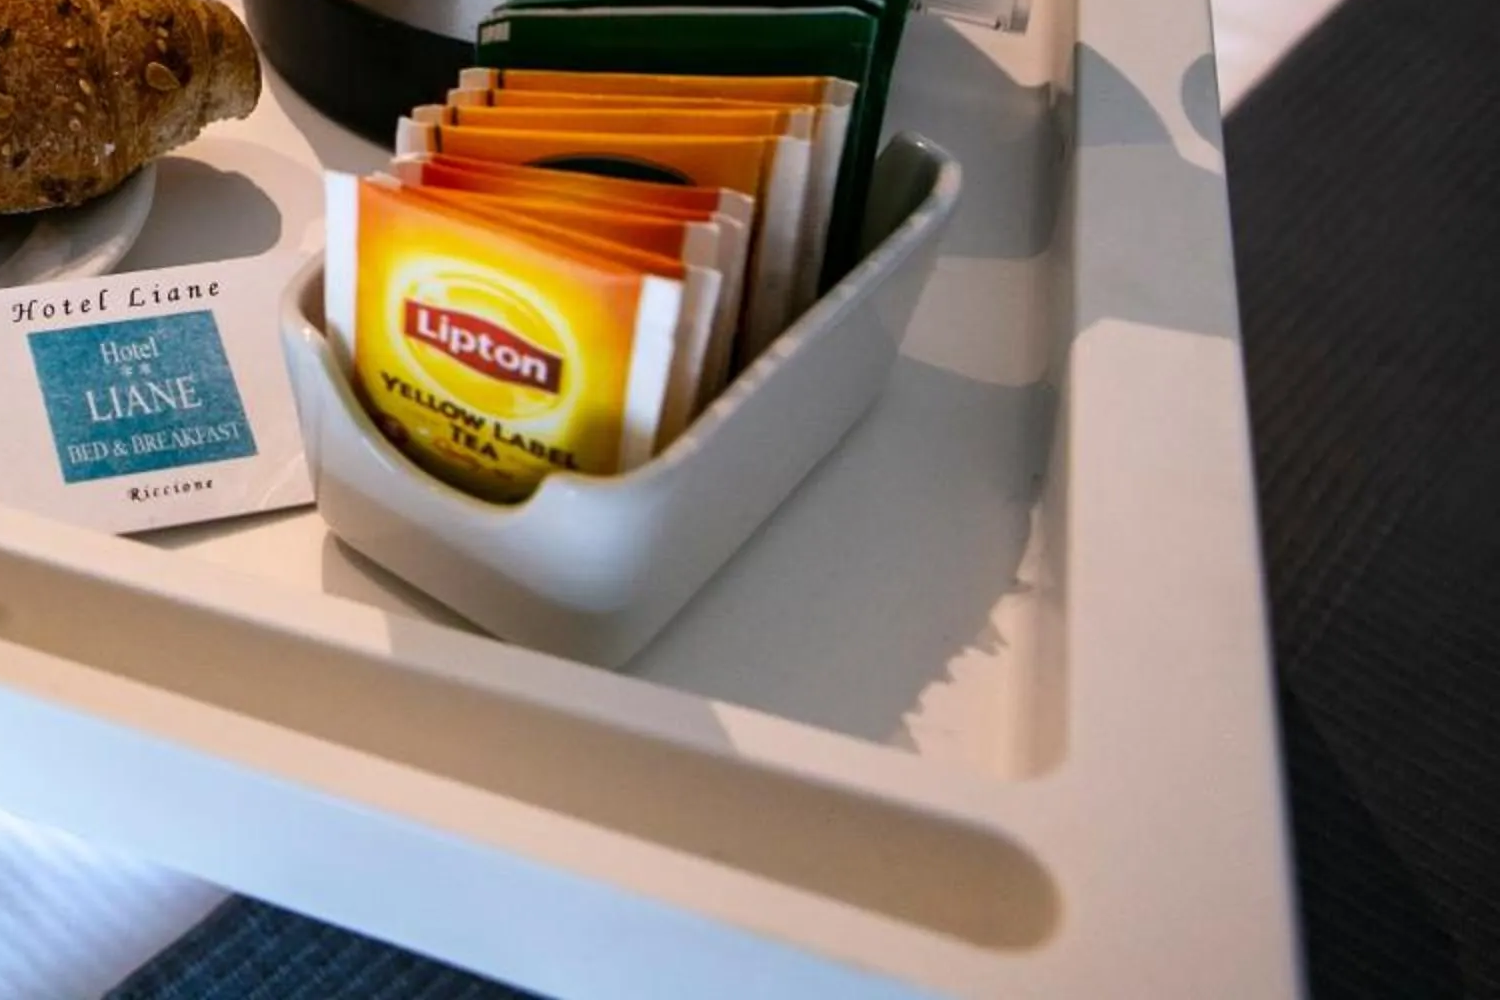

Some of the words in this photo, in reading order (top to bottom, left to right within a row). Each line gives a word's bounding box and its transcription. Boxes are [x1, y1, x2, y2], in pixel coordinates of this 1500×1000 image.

[12, 289, 108, 322] Hotel
[129, 280, 220, 307] Liane
[100, 337, 160, 364] Hotel
[416, 308, 548, 383] Lipton
[85, 375, 202, 422] LIANE
[381, 371, 486, 432] YELLOW
[493, 420, 579, 470] LABEL
[68, 440, 108, 464] BED
[113, 440, 128, 457] &
[132, 421, 241, 454] BREAKFAST
[450, 424, 499, 461] TEA
[128, 478, 214, 502] Riccione
